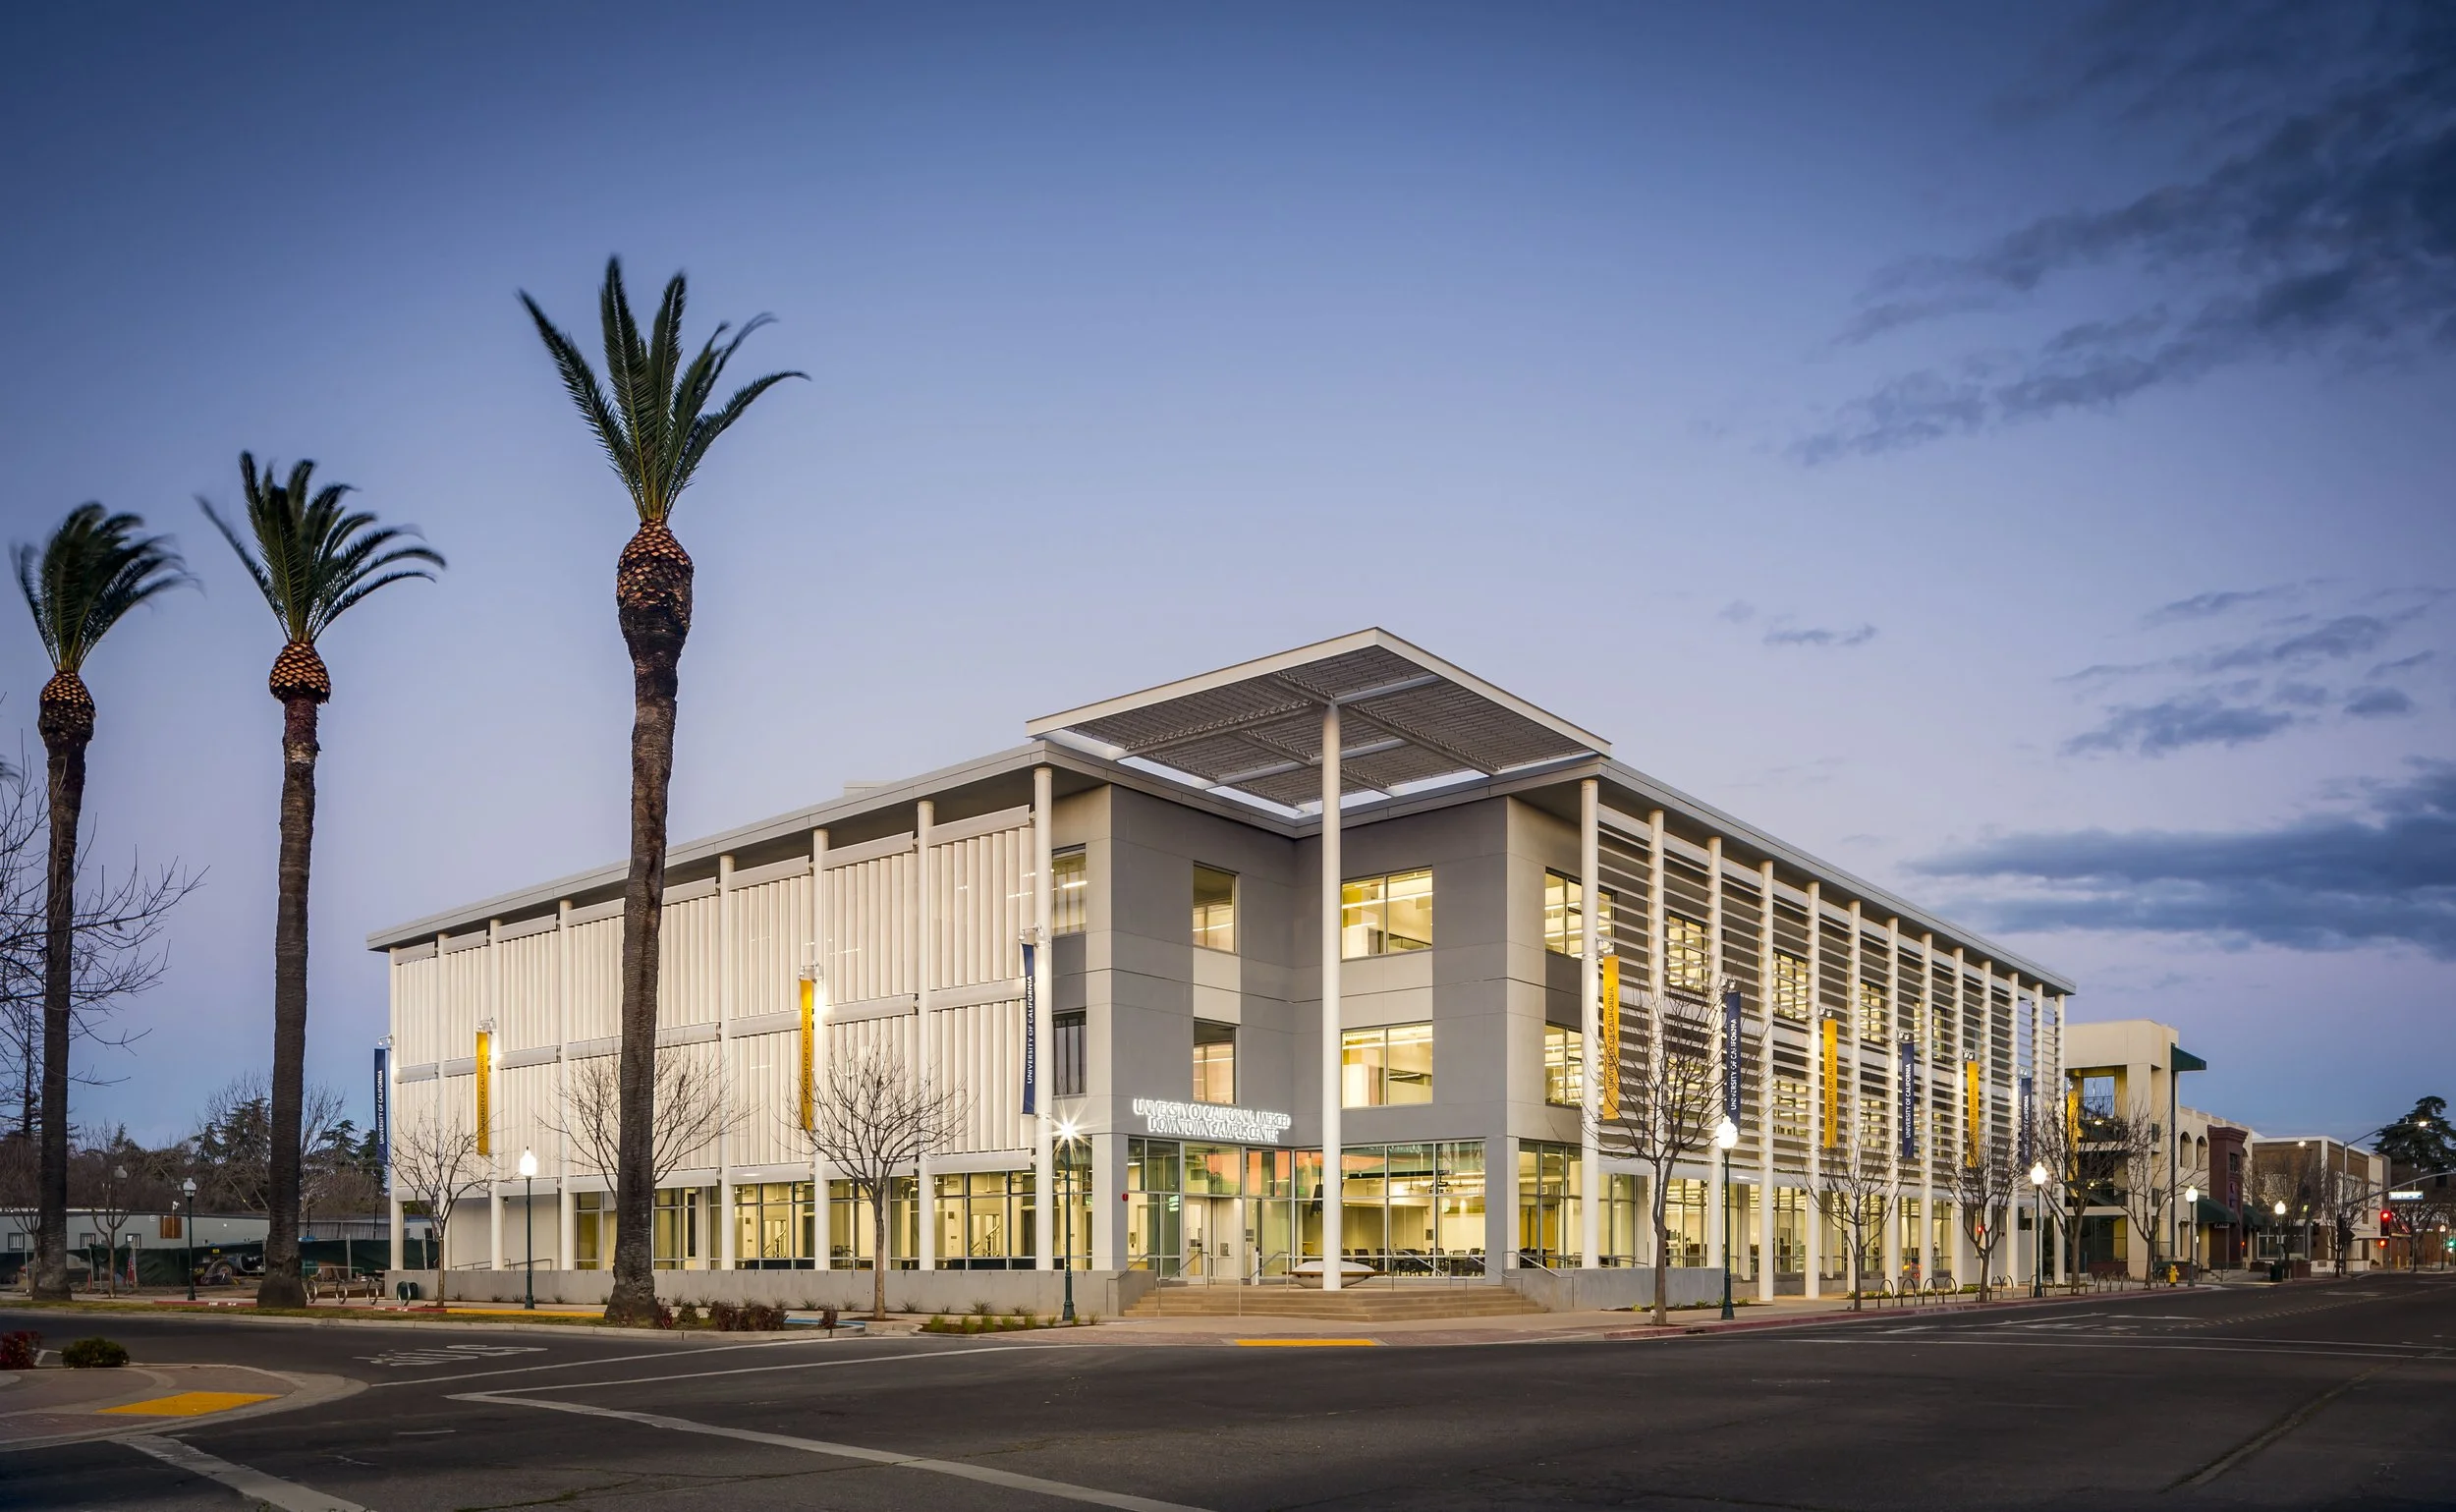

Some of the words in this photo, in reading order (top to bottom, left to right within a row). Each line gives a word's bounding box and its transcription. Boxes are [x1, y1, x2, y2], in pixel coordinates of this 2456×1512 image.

[1027, 1025, 1033, 1036] OF
[1608, 1033, 1615, 1044] OF
[804, 1052, 809, 1062] OF
[1730, 1060, 1737, 1070] OF
[1827, 1081, 1834, 1090] OF
[479, 1090, 486, 1099] OF
[1905, 1097, 1912, 1106] OF
[377, 1103, 384, 1113] OF
[1147, 1115, 1210, 1137] DOWNTOWN
[1209, 1120, 1248, 1140] CAMPUS
